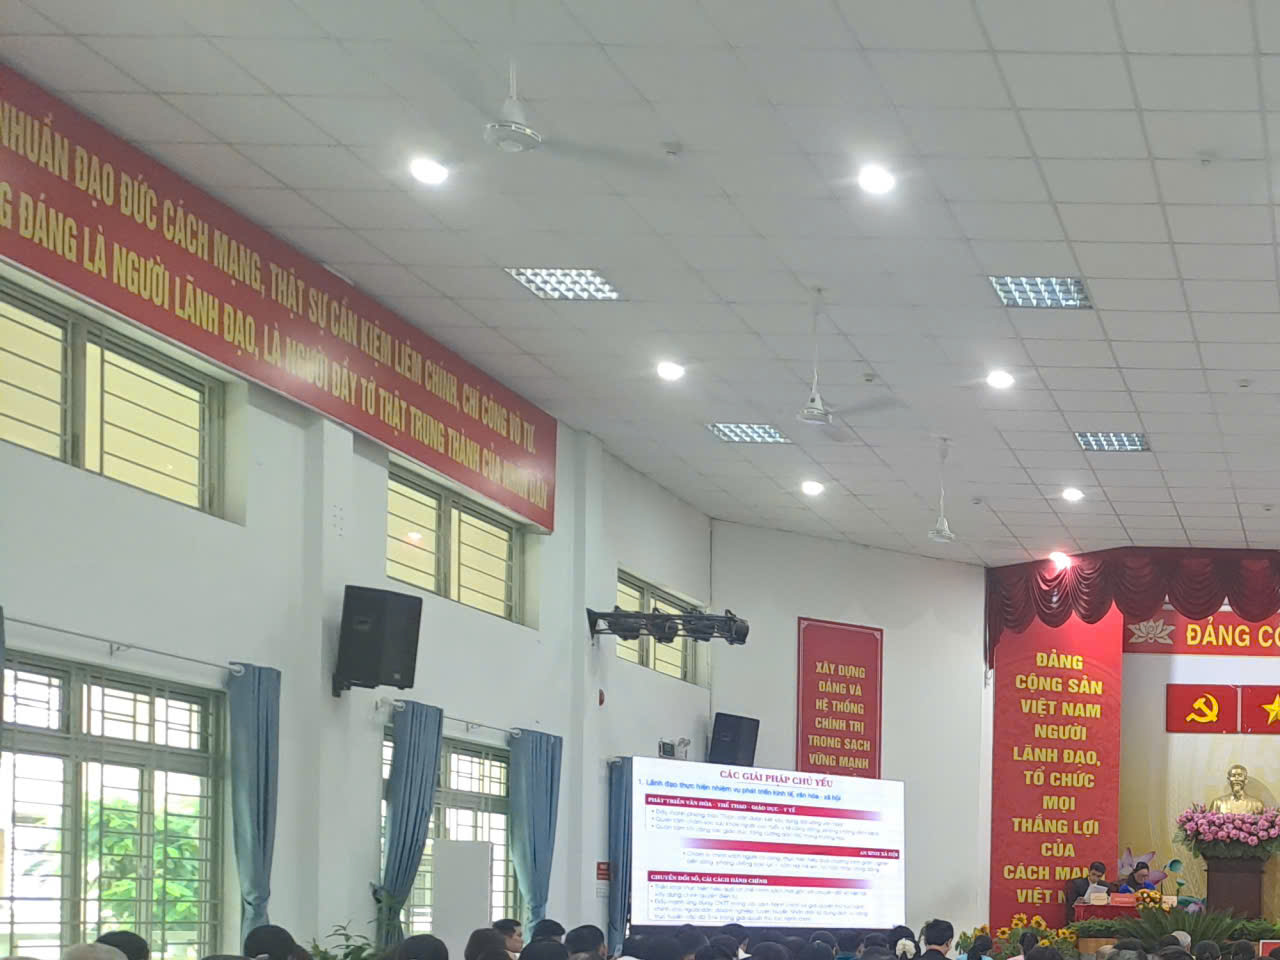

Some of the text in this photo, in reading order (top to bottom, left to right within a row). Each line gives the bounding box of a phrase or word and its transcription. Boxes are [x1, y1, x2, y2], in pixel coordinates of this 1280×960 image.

[75, 145, 114, 207] ĐẠO
[120, 171, 157, 231] ĐỨC
[162, 199, 209, 261] CÁCH
[213, 229, 265, 298] MẠNG,
[269, 262, 304, 319] THẬT
[308, 287, 329, 335] SỰ
[360, 317, 392, 367] KIỆM
[395, 339, 422, 385] LIÊM
[425, 359, 460, 412] CHÍNH,
[462, 382, 480, 420] CHÍ
[482, 394, 507, 437] CÔNG
[509, 411, 521, 445] VÔ
[19, 192, 78, 263] ĐÁNG
[83, 225, 107, 279] LÀ
[113, 242, 170, 311] NGƯỜI
[175, 275, 219, 336] LÃNH
[223, 303, 259, 361] ĐẠO,
[263, 321, 282, 369] LÀ
[360, 375, 376, 415] TỚ
[378, 387, 408, 435] THẬT
[409, 405, 445, 454] TRUNG
[447, 426, 481, 472] THÀNH
[482, 443, 504, 484] CỦA
[1186, 616, 1250, 648] ĐẢNG
[1036, 648, 1084, 670] ĐẢNG
[815, 660, 866, 679] XÂY DỰNG
[818, 678, 862, 696] ĐẢNG VÀ
[1015, 674, 1103, 695] CỘNG SẢN
[815, 697, 865, 715] HỆ THỐNG
[1020, 698, 1101, 718] VIỆT NAM
[815, 716, 864, 735] CHÍNH TRỊ
[1035, 723, 1087, 741] NGƯỜI
[808, 734, 871, 753] TRONG SẠCH
[808, 750, 869, 770] VỮNG MẠNH
[1013, 744, 1101, 767] LÃNH ĐẠO,
[720, 769, 740, 780] CÁC
[765, 773, 791, 784] PHÁP
[1024, 765, 1095, 788] TỔ CHỨC
[1042, 796, 1075, 813] MỌI
[1012, 815, 1099, 838] THẮNG LỢI
[1041, 839, 1075, 858] CỦA
[1003, 864, 1049, 881] CÁCH
[1017, 886, 1052, 906] VIỆT
